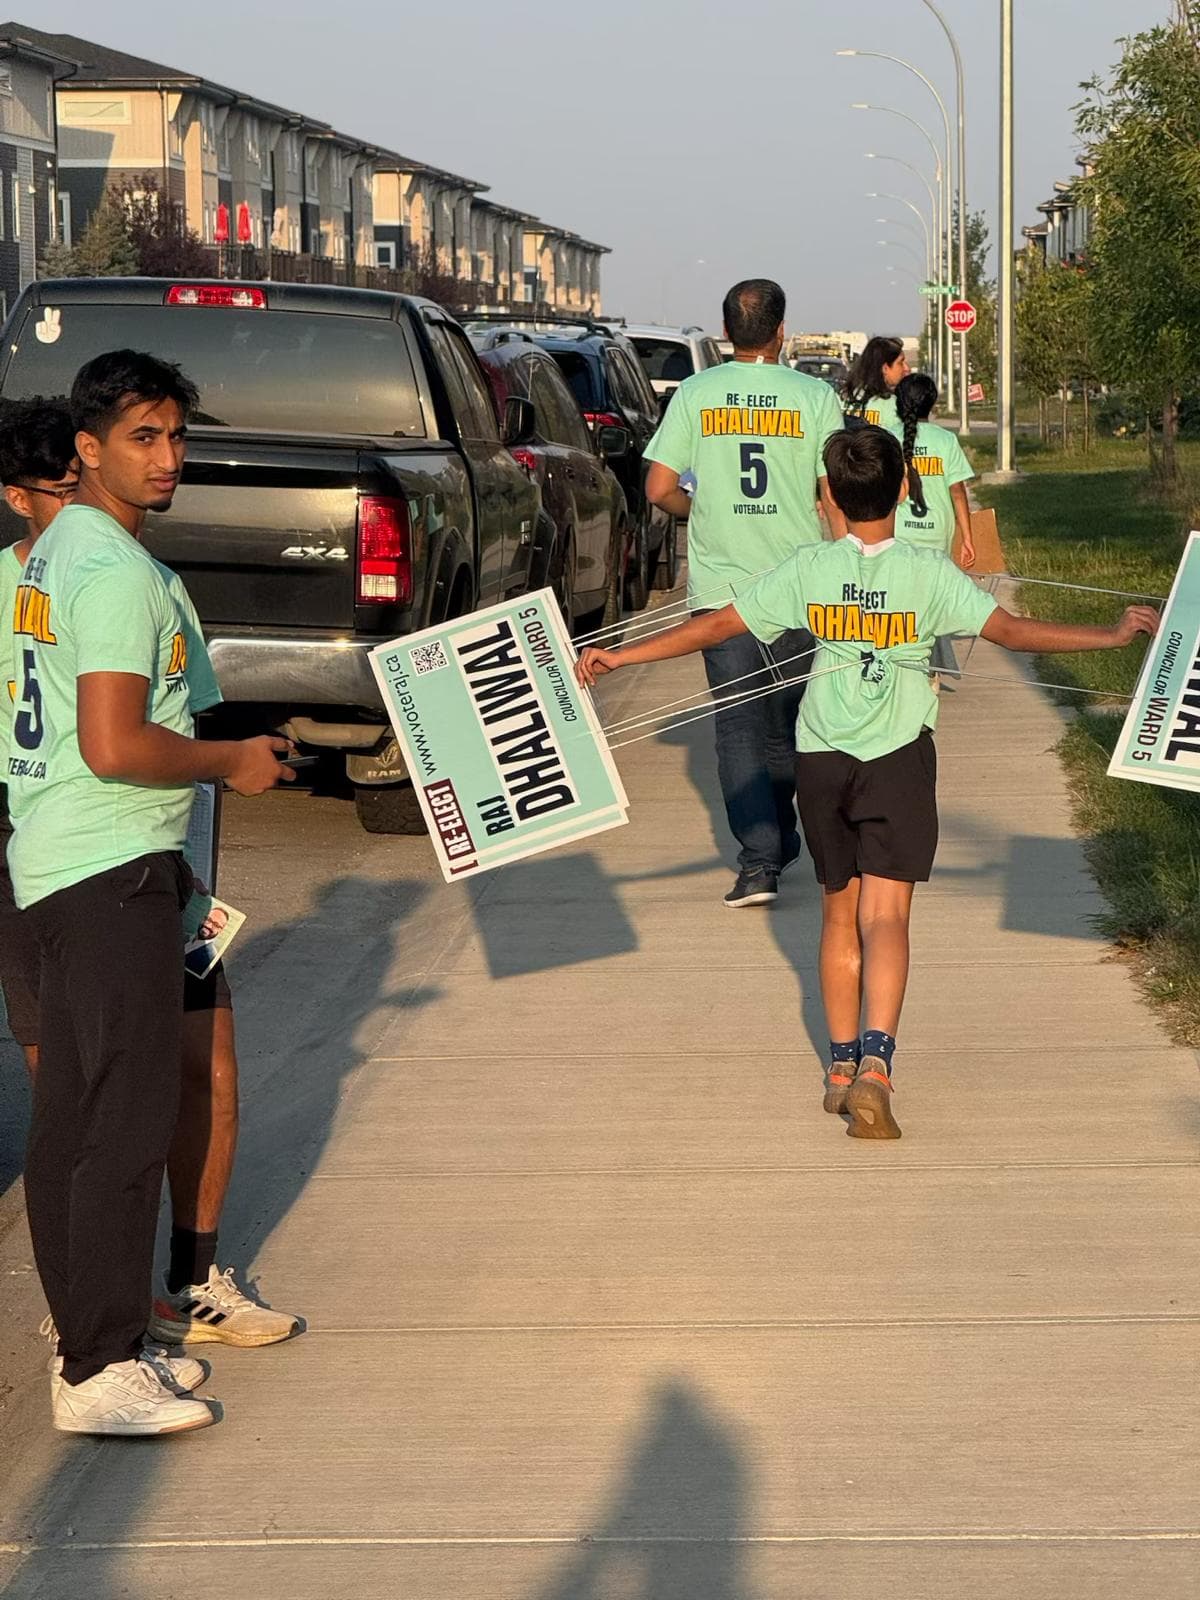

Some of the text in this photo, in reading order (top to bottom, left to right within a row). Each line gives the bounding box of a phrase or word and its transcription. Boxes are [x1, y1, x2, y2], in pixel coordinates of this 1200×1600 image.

[947, 310, 974, 324] STOP
[700, 407, 805, 440] DHALIWAL
[739, 443, 769, 499] 5
[733, 503, 778, 516] VOTERAJ.CA
[518, 607, 578, 722] COUNCILLOR WARD 5
[1152, 631, 1183, 696] COUNCILLOR
[14, 649, 44, 750] 5
[386, 654, 438, 776] www.voteraj.ca
[457, 620, 576, 821] DHALIWAL
[1137, 697, 1170, 747] WARD
[367, 769, 401, 778] RAM
[1132, 750, 1153, 762] 5
[427, 785, 472, 856] RE-ELECT
[476, 795, 515, 836] RAJ
